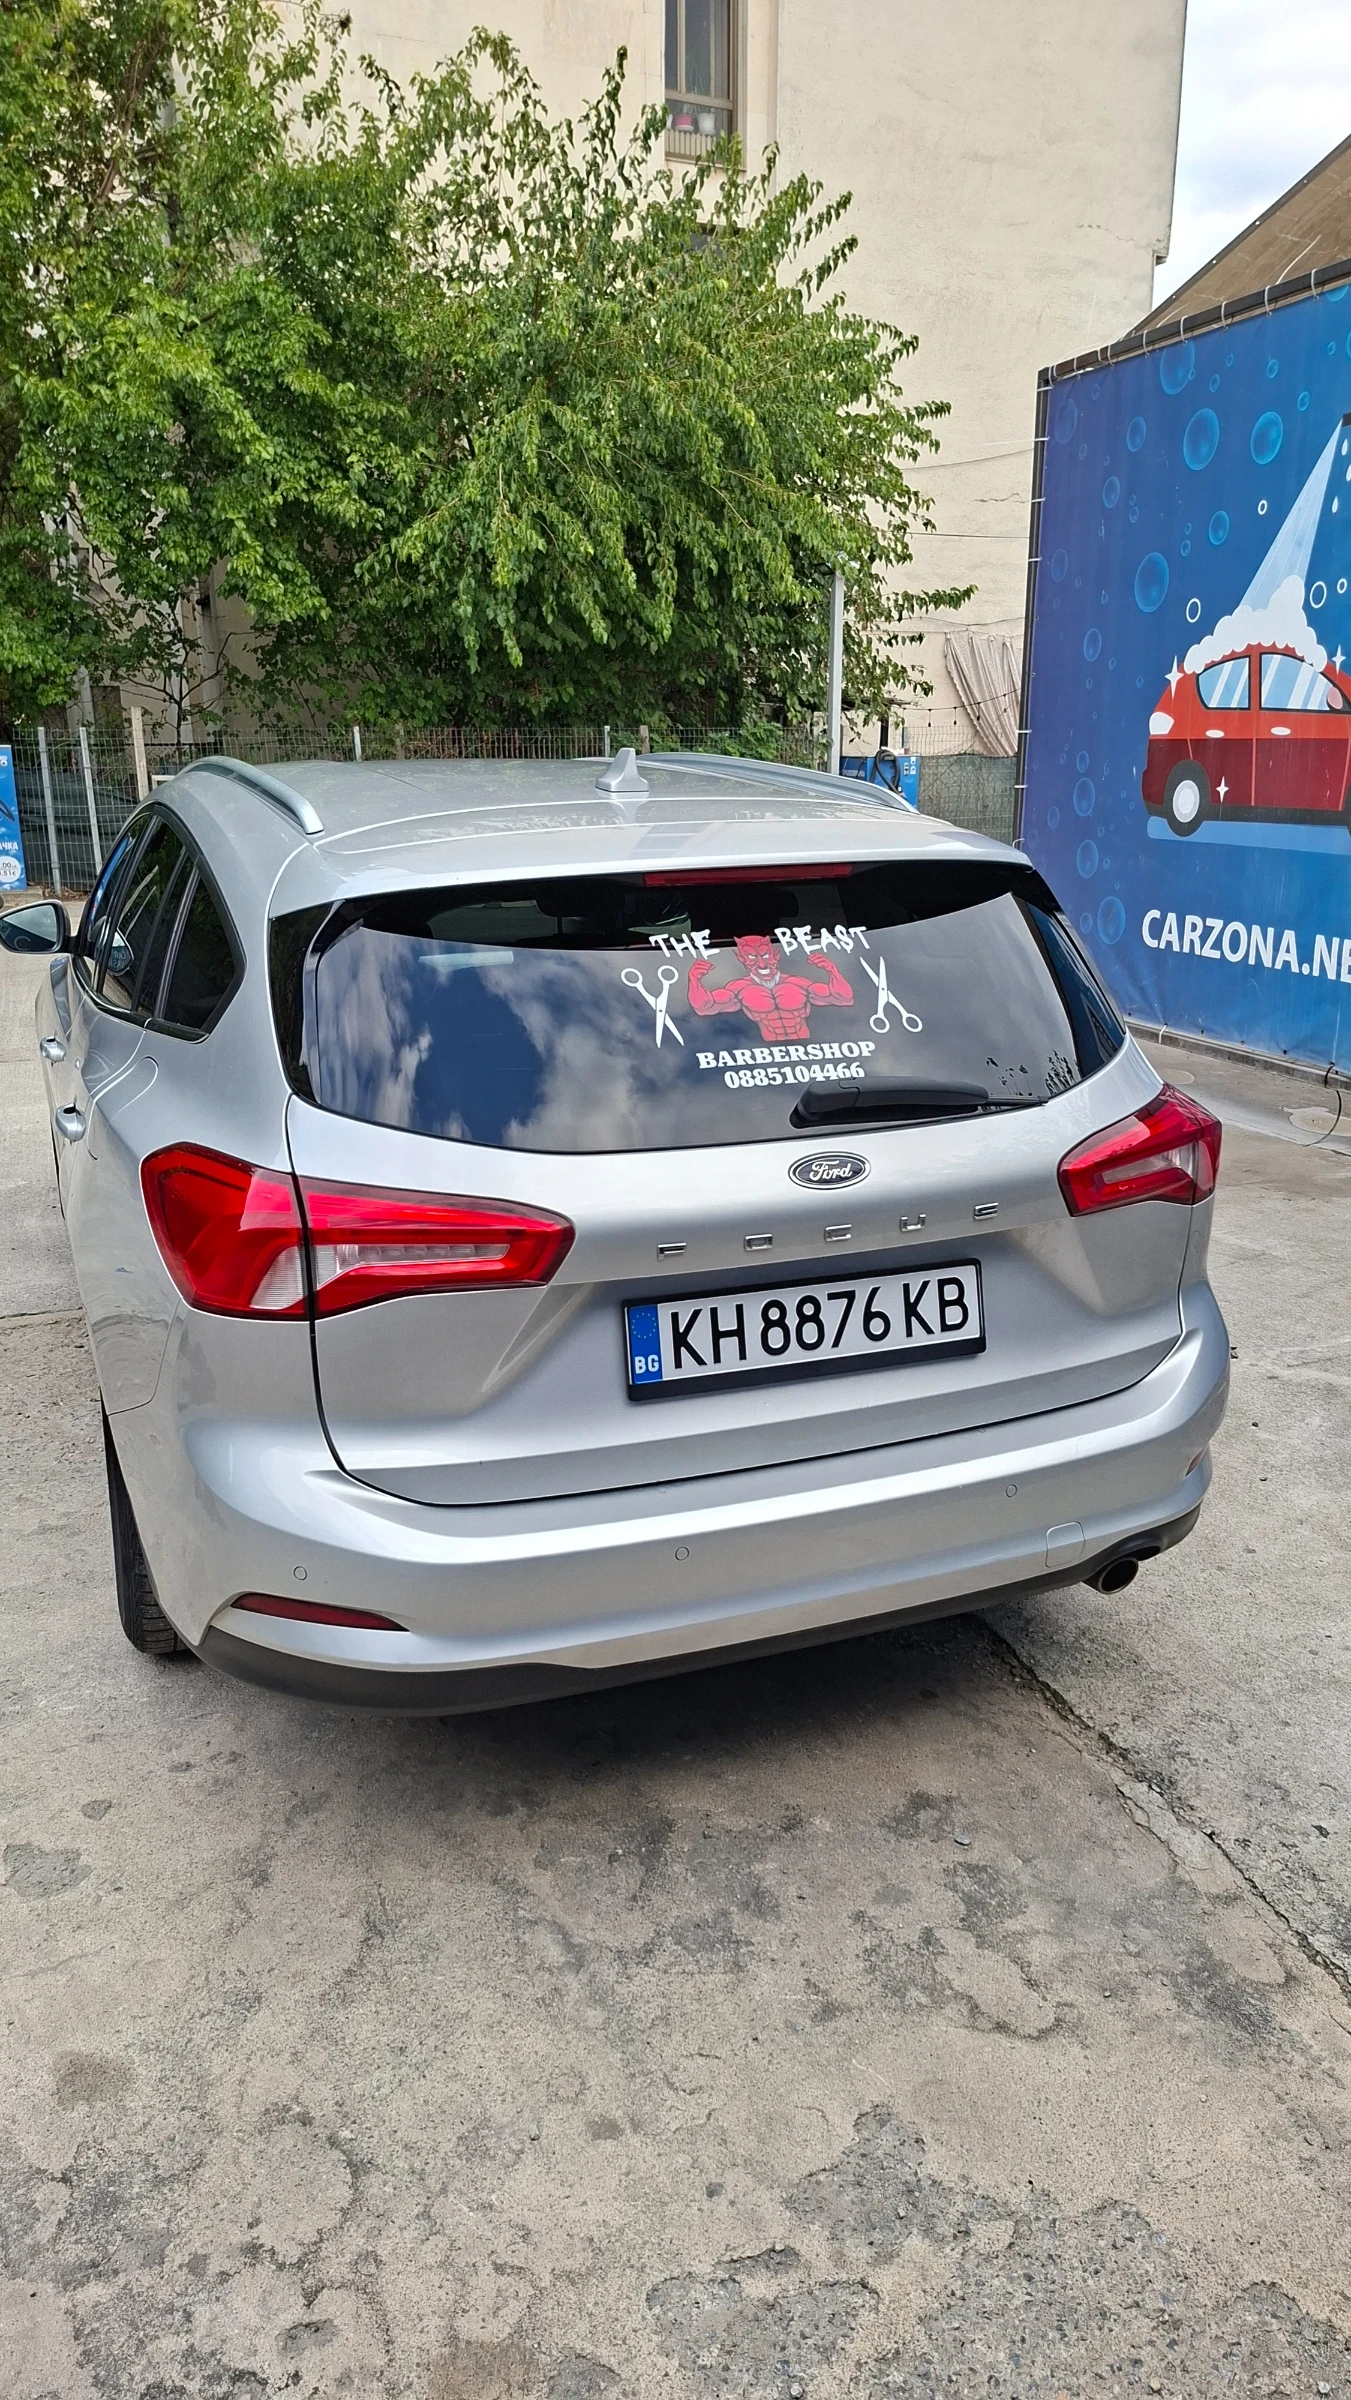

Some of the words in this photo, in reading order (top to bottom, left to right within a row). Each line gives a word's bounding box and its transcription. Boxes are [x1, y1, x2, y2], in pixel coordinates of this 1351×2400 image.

[649, 929, 720, 960] THE
[774, 925, 870, 956] BEAST
[696, 1041, 876, 1069] BARBERSHOP
[723, 1062, 866, 1089] 0885104466
[809, 1160, 853, 1181] Ford
[657, 1202, 999, 1260] FOCUS
[760, 1286, 891, 1356] 8876
[634, 1355, 660, 1374] BG
